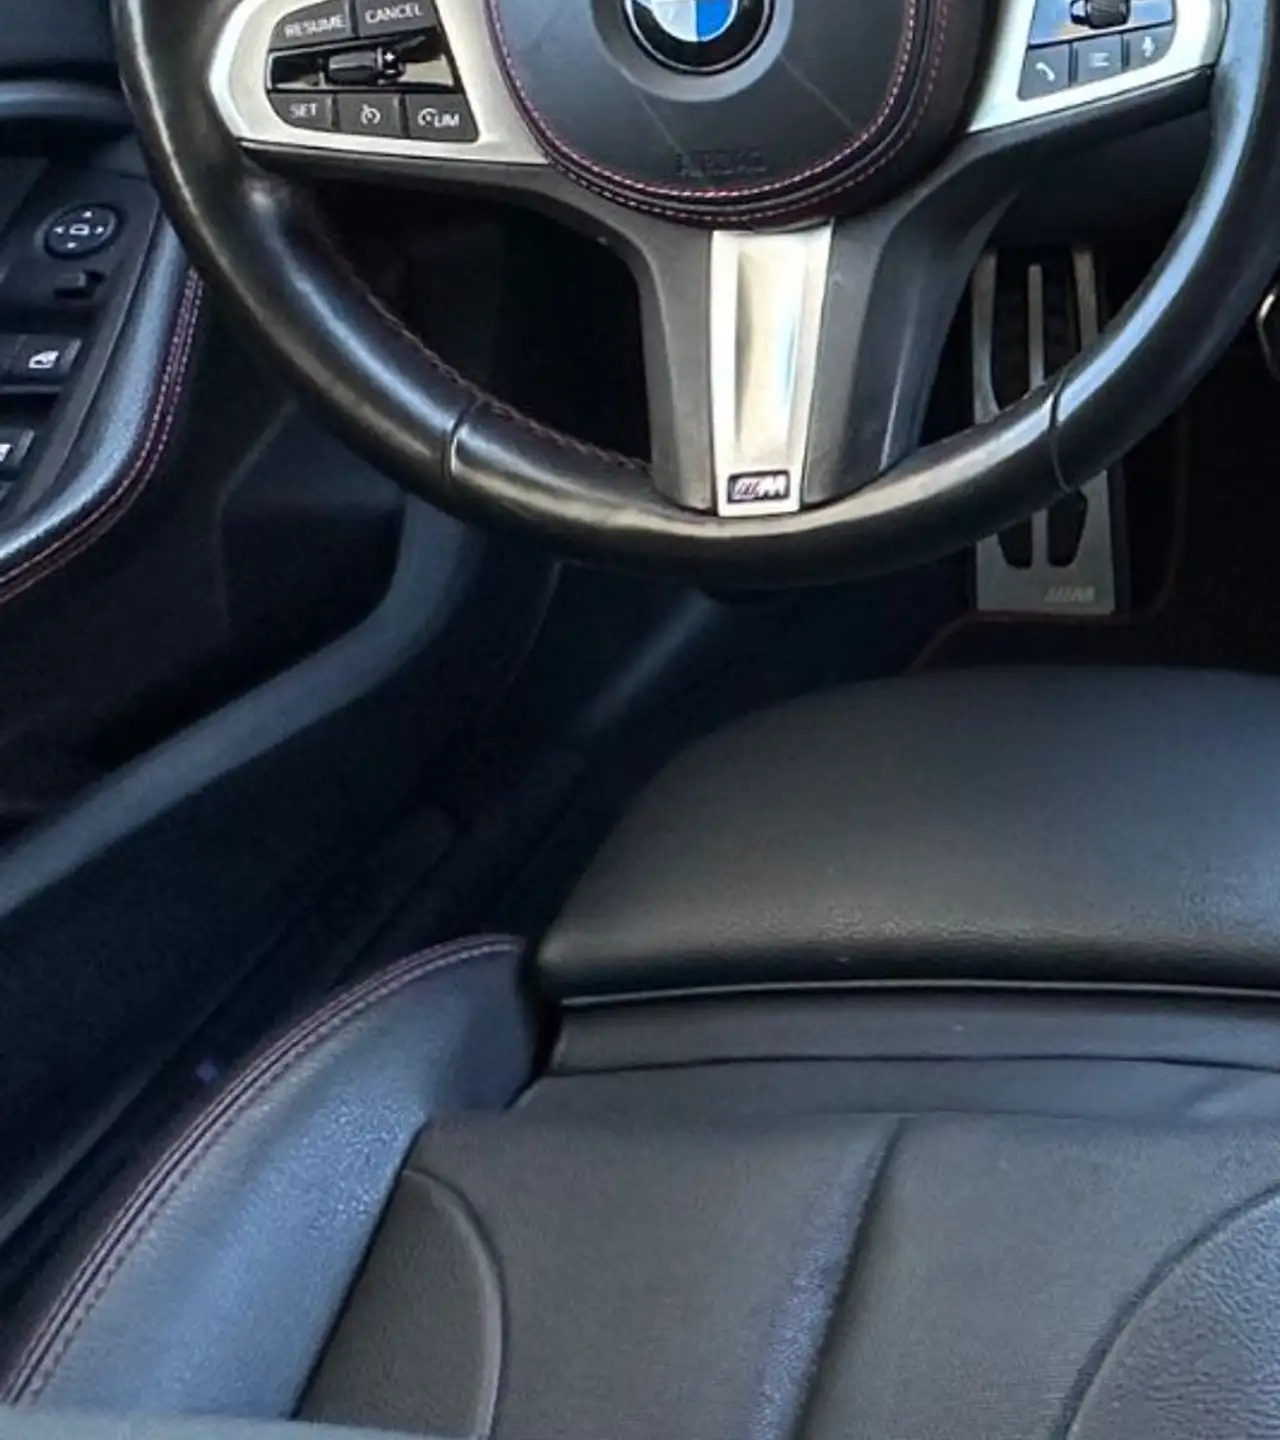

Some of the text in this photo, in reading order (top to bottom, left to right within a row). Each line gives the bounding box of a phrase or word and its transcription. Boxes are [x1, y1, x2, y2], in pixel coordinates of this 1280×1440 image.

[365, 2, 423, 24] CANCEL
[284, 14, 347, 37] RESUME
[290, 103, 317, 118] SET
[435, 113, 460, 128] LIM
